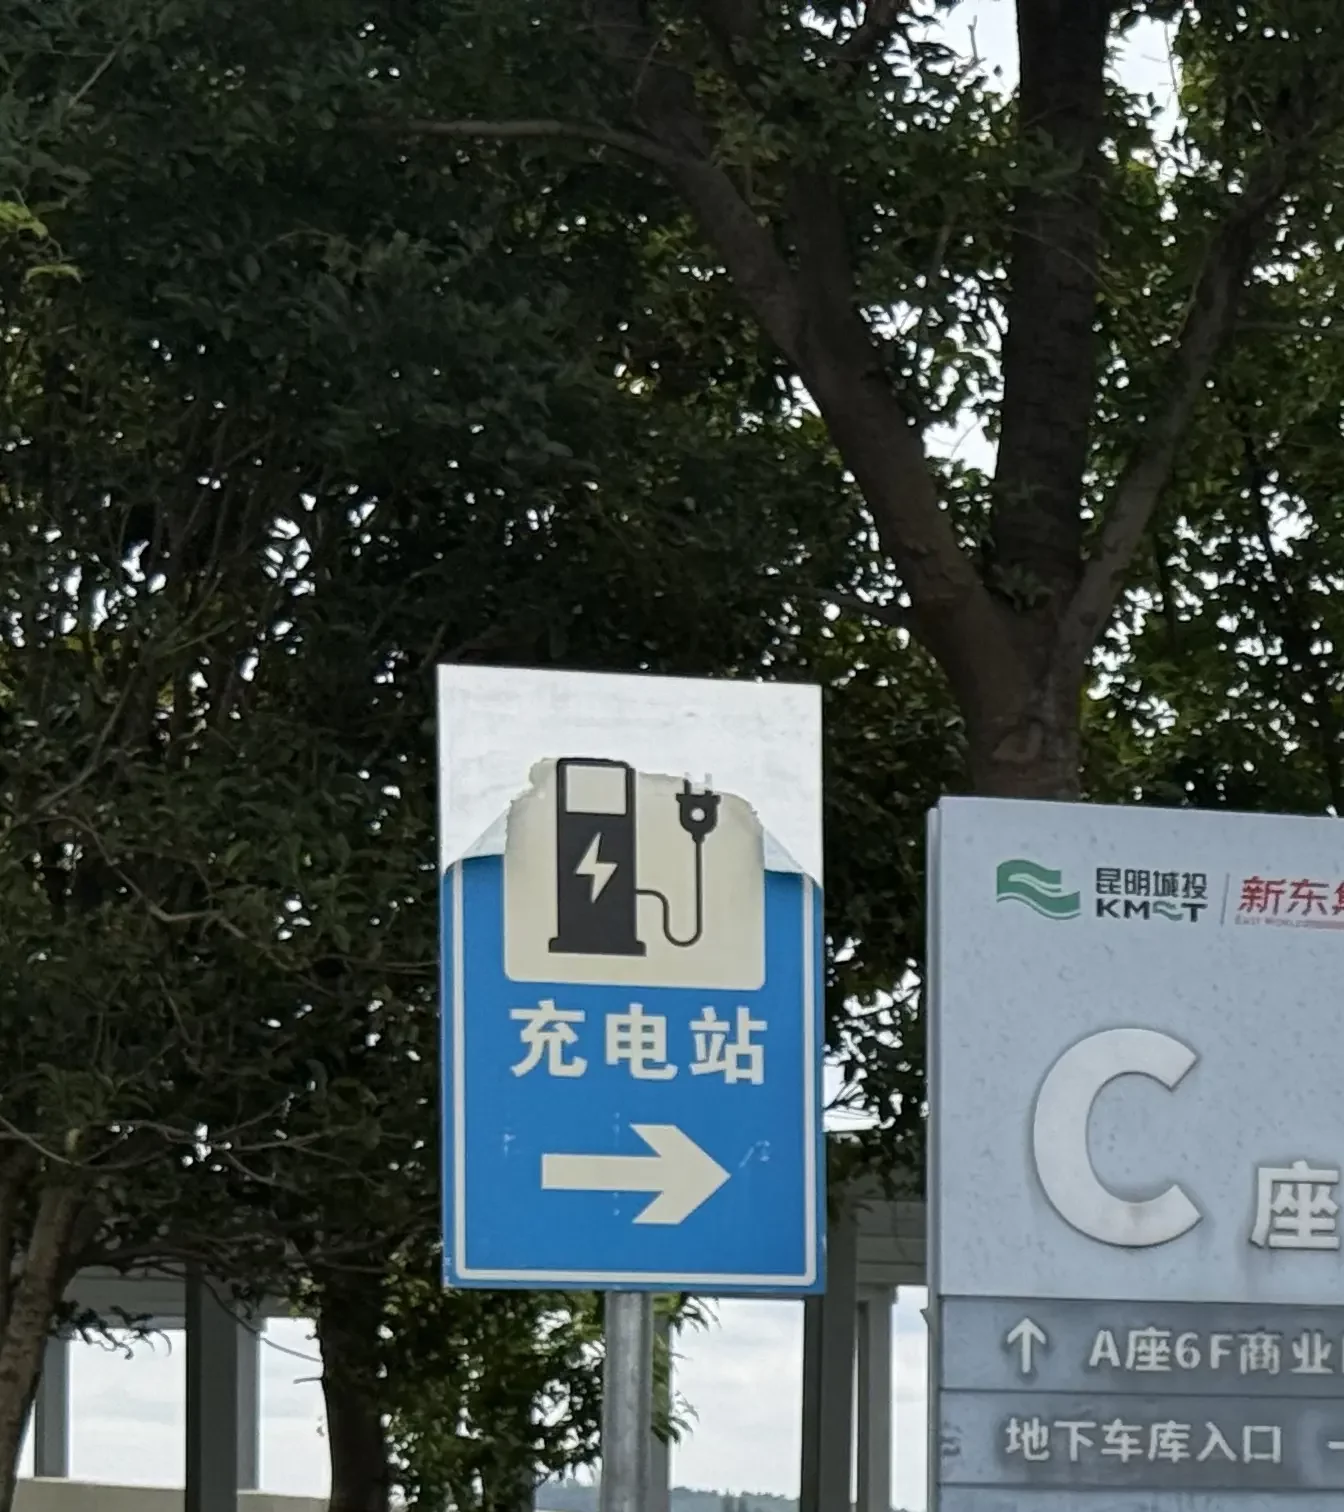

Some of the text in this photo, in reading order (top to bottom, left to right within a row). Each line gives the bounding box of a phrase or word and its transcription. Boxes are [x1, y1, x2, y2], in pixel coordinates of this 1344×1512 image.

[1096, 868, 1208, 900] 昆明城投
[509, 1000, 767, 1085] 充电站
[1005, 1416, 1283, 1464] 地下车库入口
